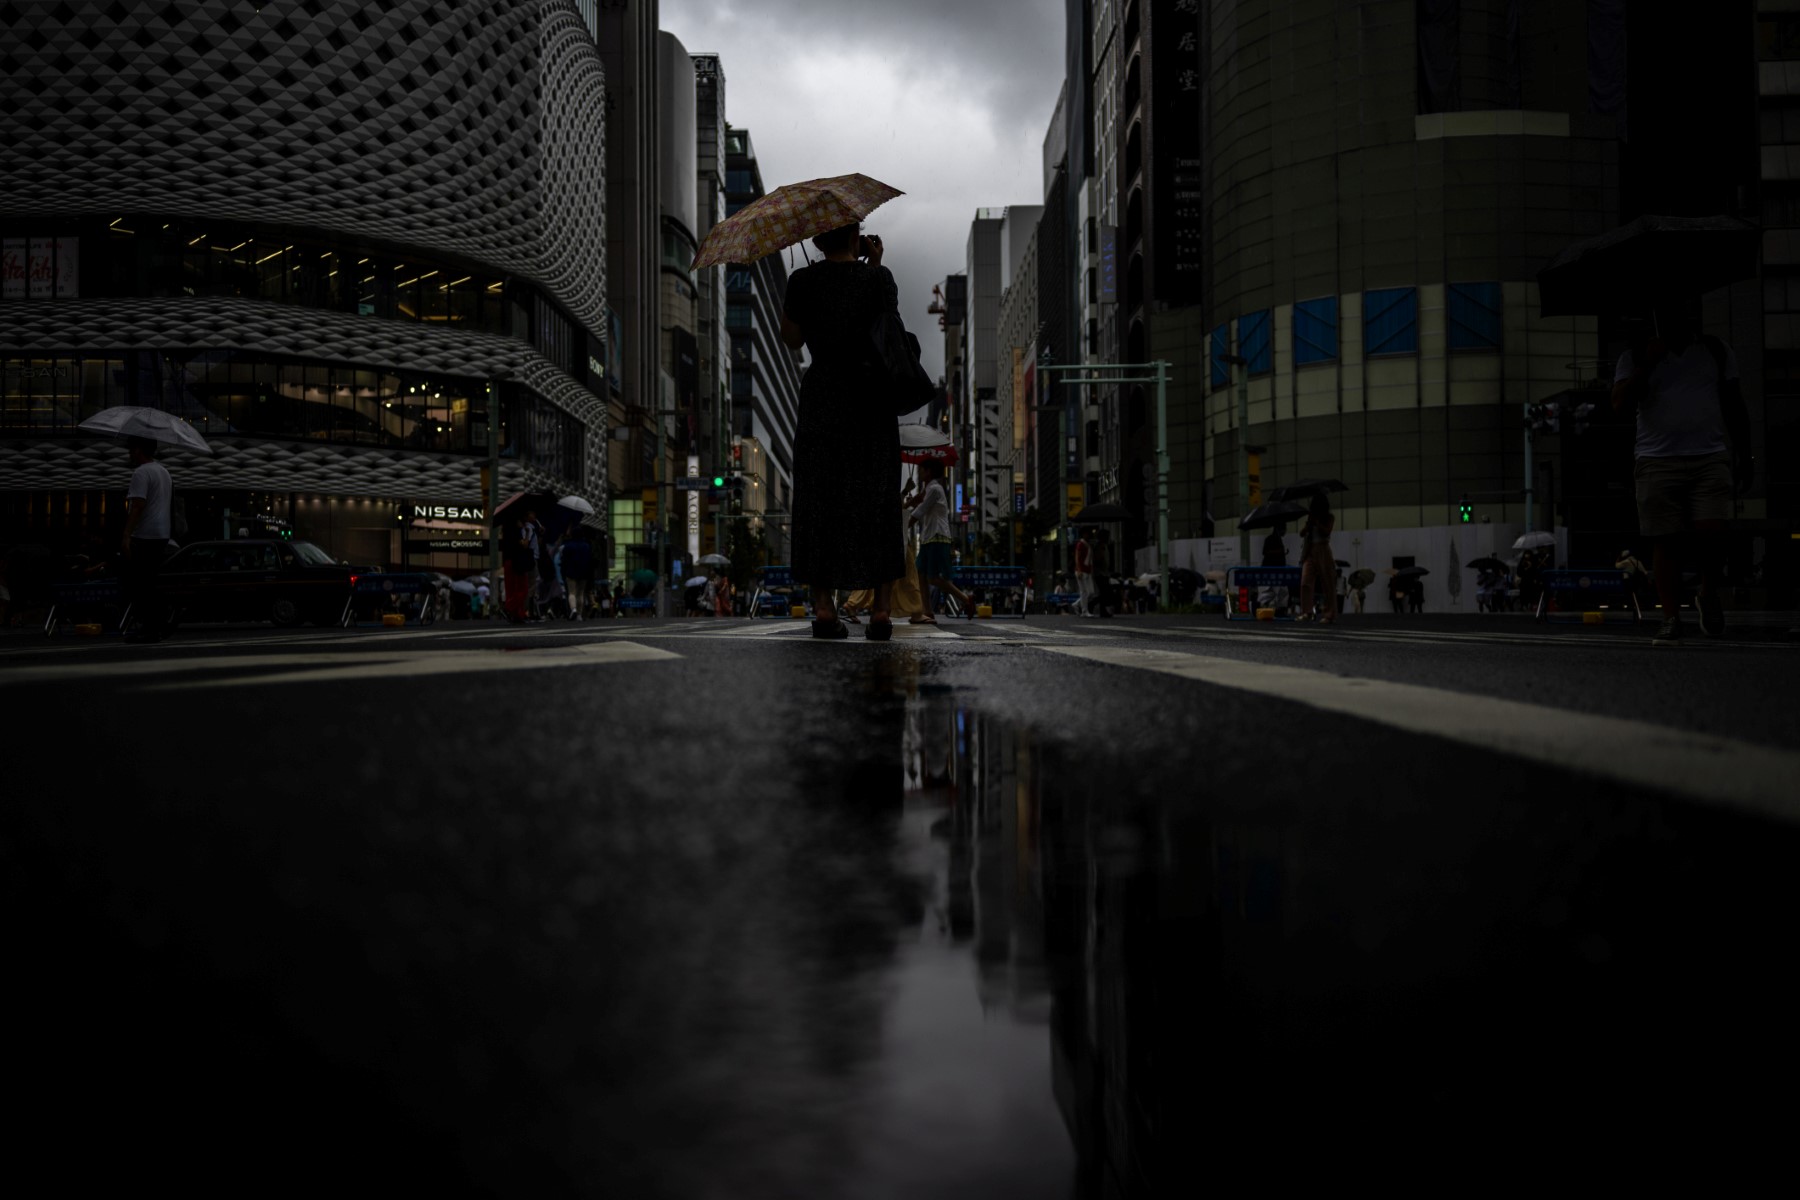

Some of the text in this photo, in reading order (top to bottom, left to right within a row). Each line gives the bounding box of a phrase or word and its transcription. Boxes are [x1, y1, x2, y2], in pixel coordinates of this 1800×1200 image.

[414, 505, 484, 519] NISSAN
[688, 504, 698, 535] CORE
[451, 540, 483, 549] CROSSING
